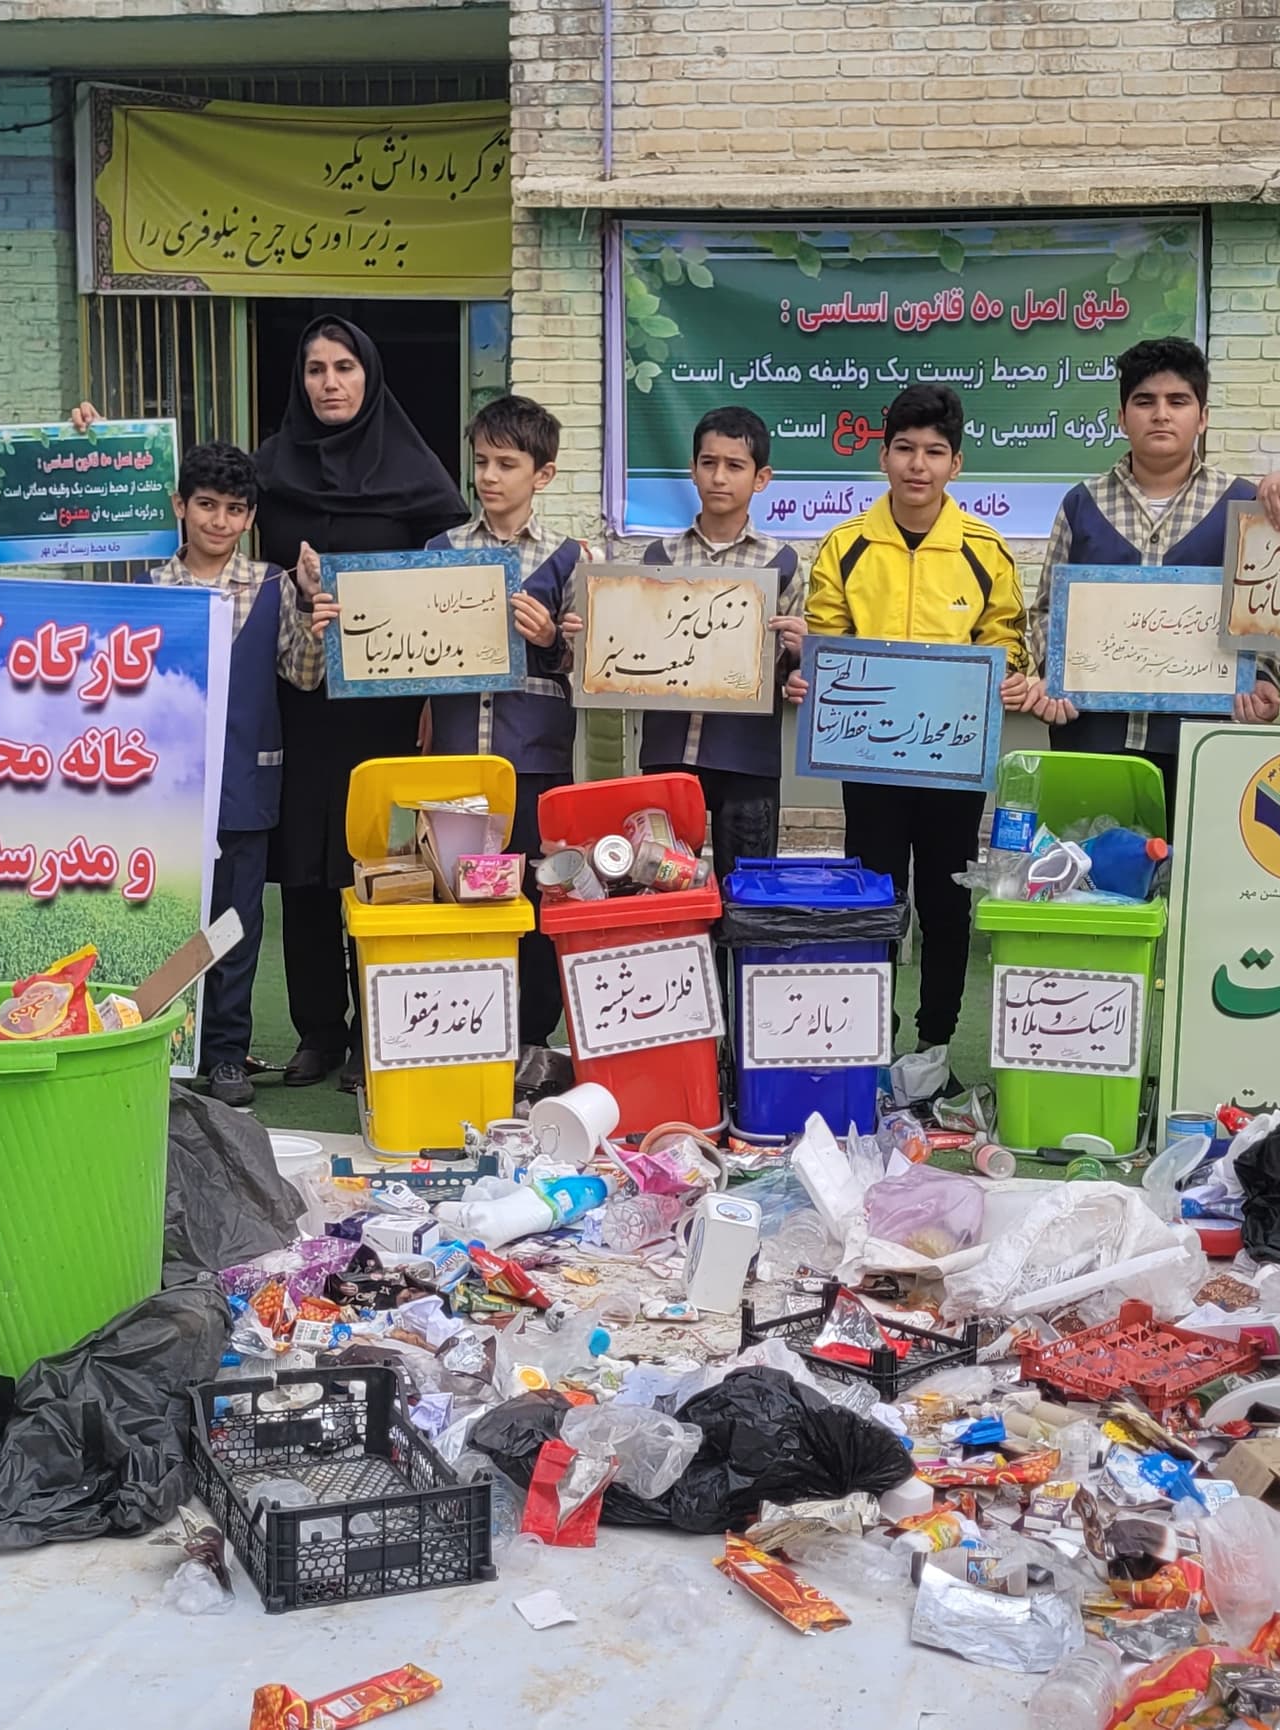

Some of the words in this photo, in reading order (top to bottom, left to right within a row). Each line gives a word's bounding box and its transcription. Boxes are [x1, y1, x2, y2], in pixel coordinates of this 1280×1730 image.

[324, 126, 393, 191] بگیرد
[372, 133, 427, 191] دانش
[435, 154, 458, 200] بار
[139, 216, 161, 247] را
[165, 207, 239, 259] نیلوفری
[245, 216, 287, 267] چرخ
[291, 207, 367, 259] آوری
[360, 219, 390, 267] زیر
[395, 235, 409, 269] به
[797, 290, 889, 332] اساسی
[894, 287, 964, 331] قانون
[971, 290, 1004, 321] ۵۰
[1011, 288, 1067, 330] اصل
[1074, 287, 1130, 330] طبق
[672, 358, 723, 382] است
[730, 354, 801, 389] همگانی
[809, 358, 868, 389] وظیفه
[876, 357, 909, 389] یک
[916, 361, 984, 388] زیست
[991, 357, 1047, 388] محیط
[1054, 357, 1070, 388] از
[770, 414, 826, 437] است.
[964, 417, 985, 439] به
[991, 411, 1056, 447] آسیبی
[4, 486, 22, 497] است
[24, 483, 47, 499] همگانی
[49, 484, 70, 498] وظیفه
[71, 485, 83, 497] یک
[85, 483, 108, 496] زیست
[109, 482, 128, 493] محیط
[767, 497, 794, 521] مهر
[802, 487, 854, 521] گلشن
[974, 492, 1010, 517] خانه
[434, 593, 440, 608] ما
[439, 589, 463, 613] ایران
[459, 588, 496, 612] طبیعت
[694, 585, 748, 638] زندگی
[1127, 609, 1157, 628] کاغذ
[10, 622, 163, 708] کارگاه
[392, 630, 428, 672] زباله
[424, 640, 464, 668] بدون
[593, 635, 624, 678] سبز
[615, 643, 695, 686] طبیعت
[1217, 663, 1228, 675] ۱۵
[842, 710, 867, 739] حفظ
[869, 712, 925, 757] زیست
[922, 718, 950, 759] محیط
[948, 714, 976, 746] حفظ
[60, 726, 160, 788] خانه
[121, 849, 156, 902] و
[1239, 890, 1257, 900] مهر
[594, 962, 634, 1030] شیشه
[631, 965, 695, 1021] فلزات
[424, 1014, 438, 1036] و
[446, 991, 494, 1035] کاغذ
[618, 1007, 628, 1025] و
[806, 995, 850, 1049] زباله
